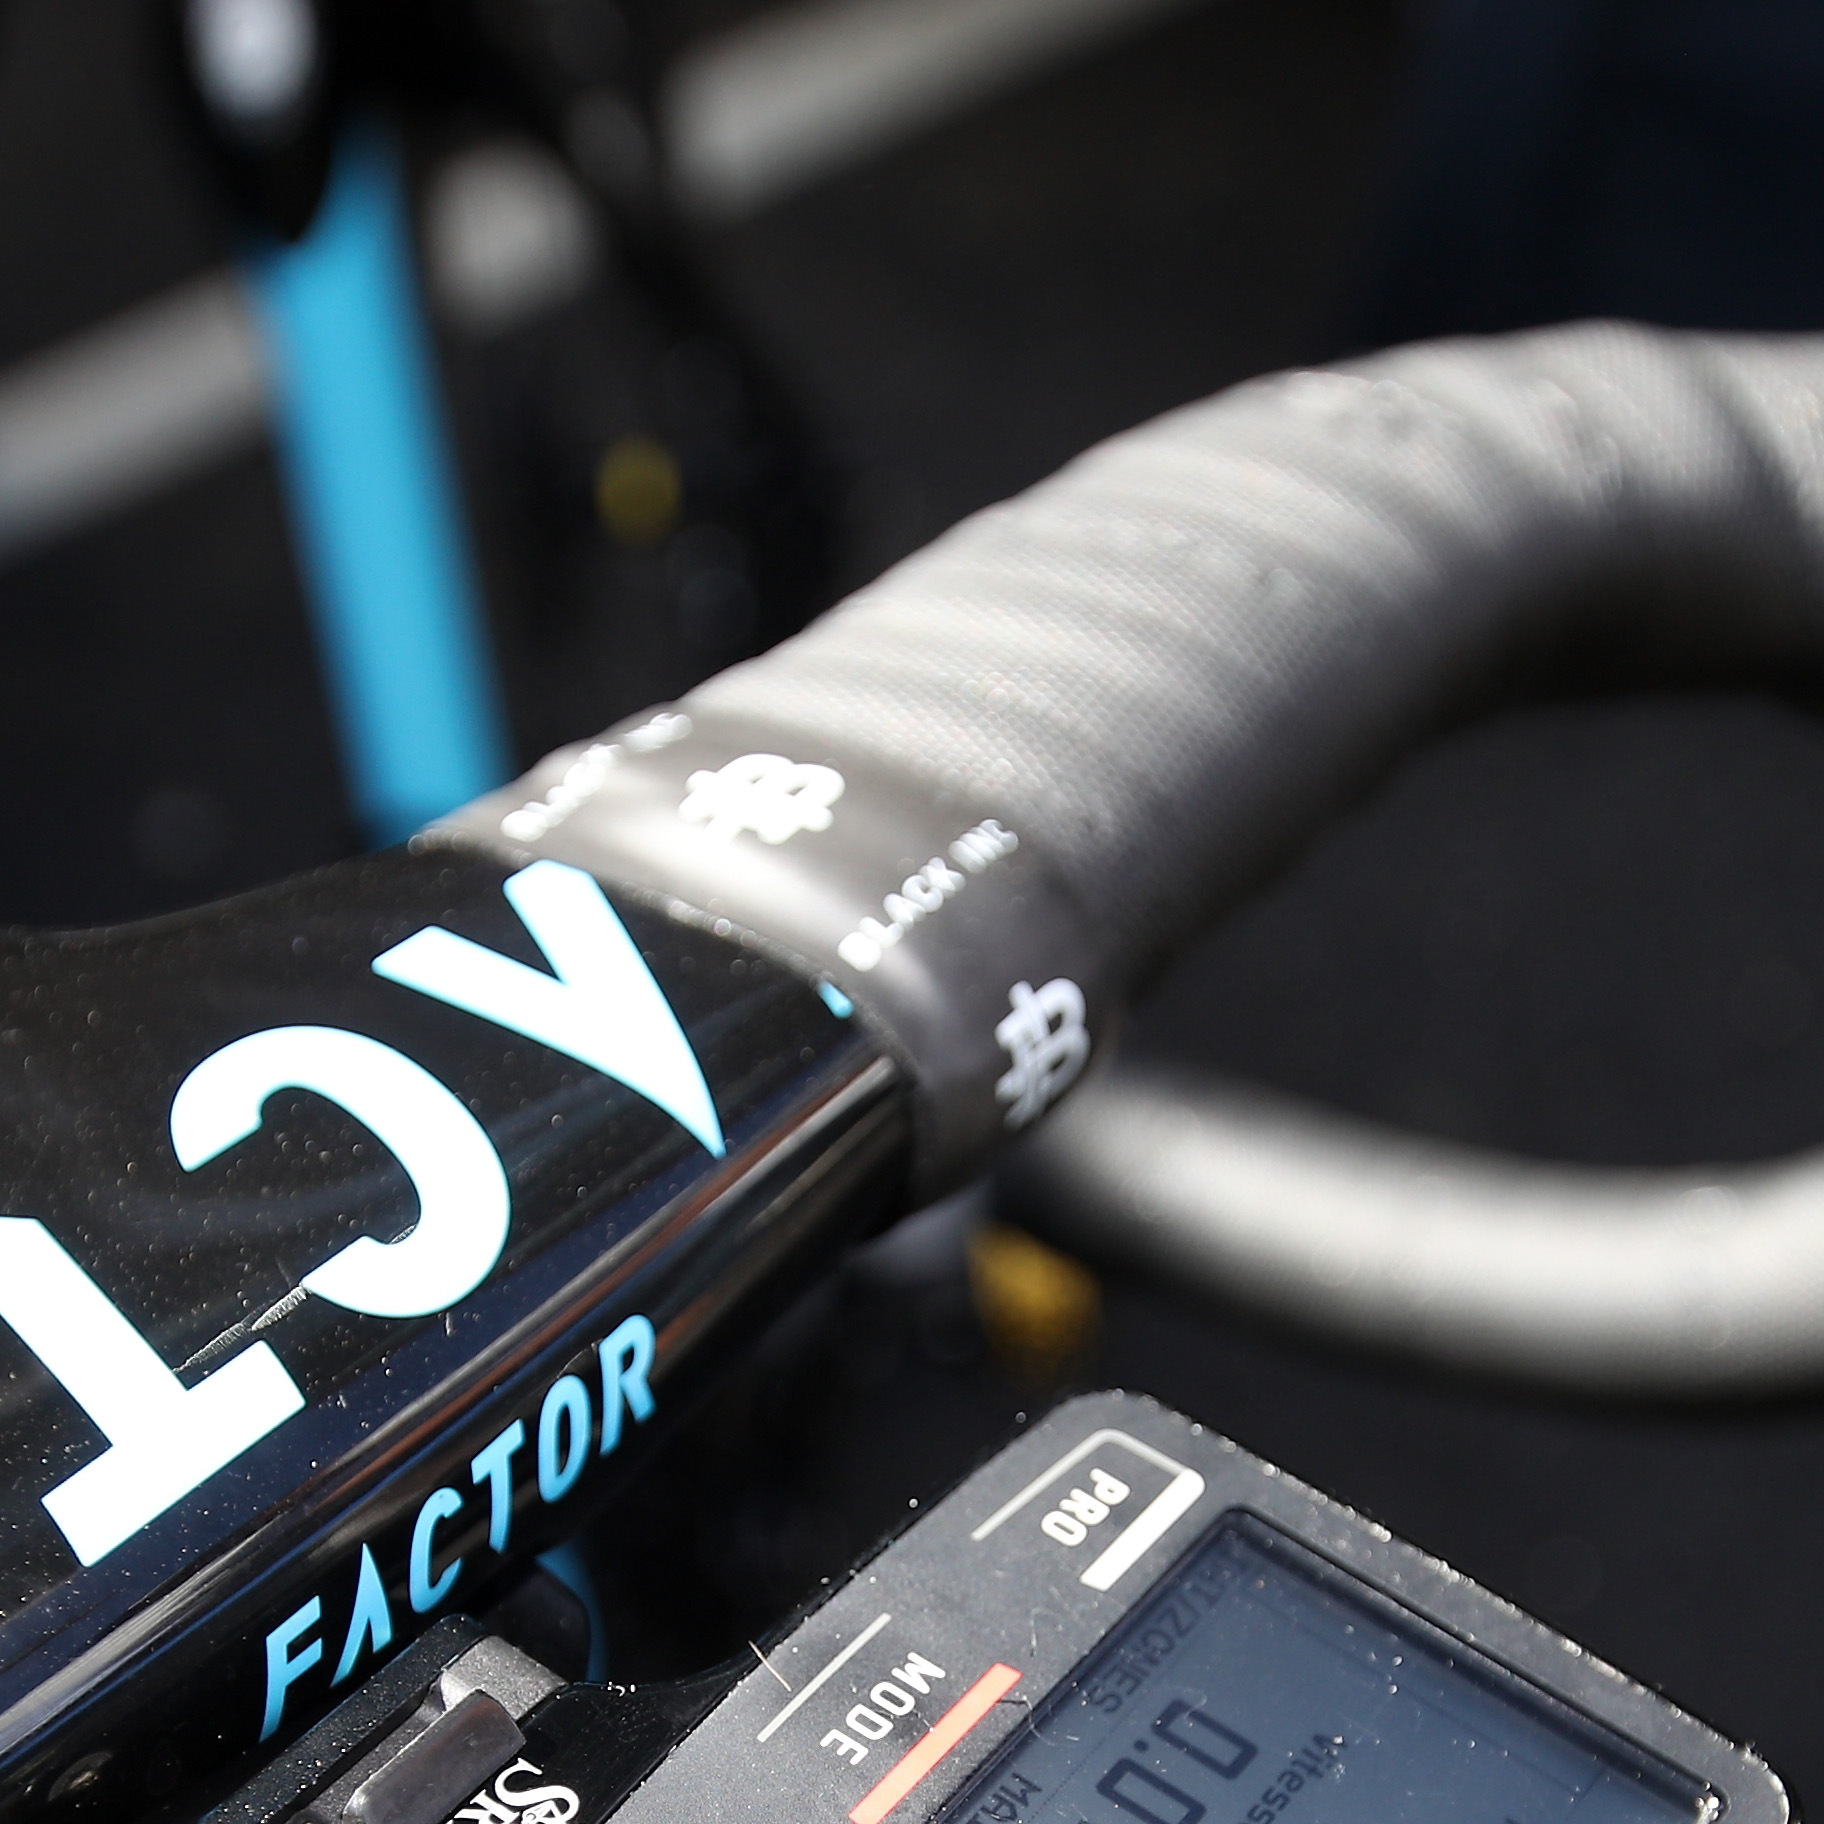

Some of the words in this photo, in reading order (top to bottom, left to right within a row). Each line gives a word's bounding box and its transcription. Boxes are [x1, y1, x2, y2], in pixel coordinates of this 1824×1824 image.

[259, 1314, 657, 1744] FACTOR
[1040, 1467, 1131, 1547] PRO
[819, 1652, 945, 1765] MODE
